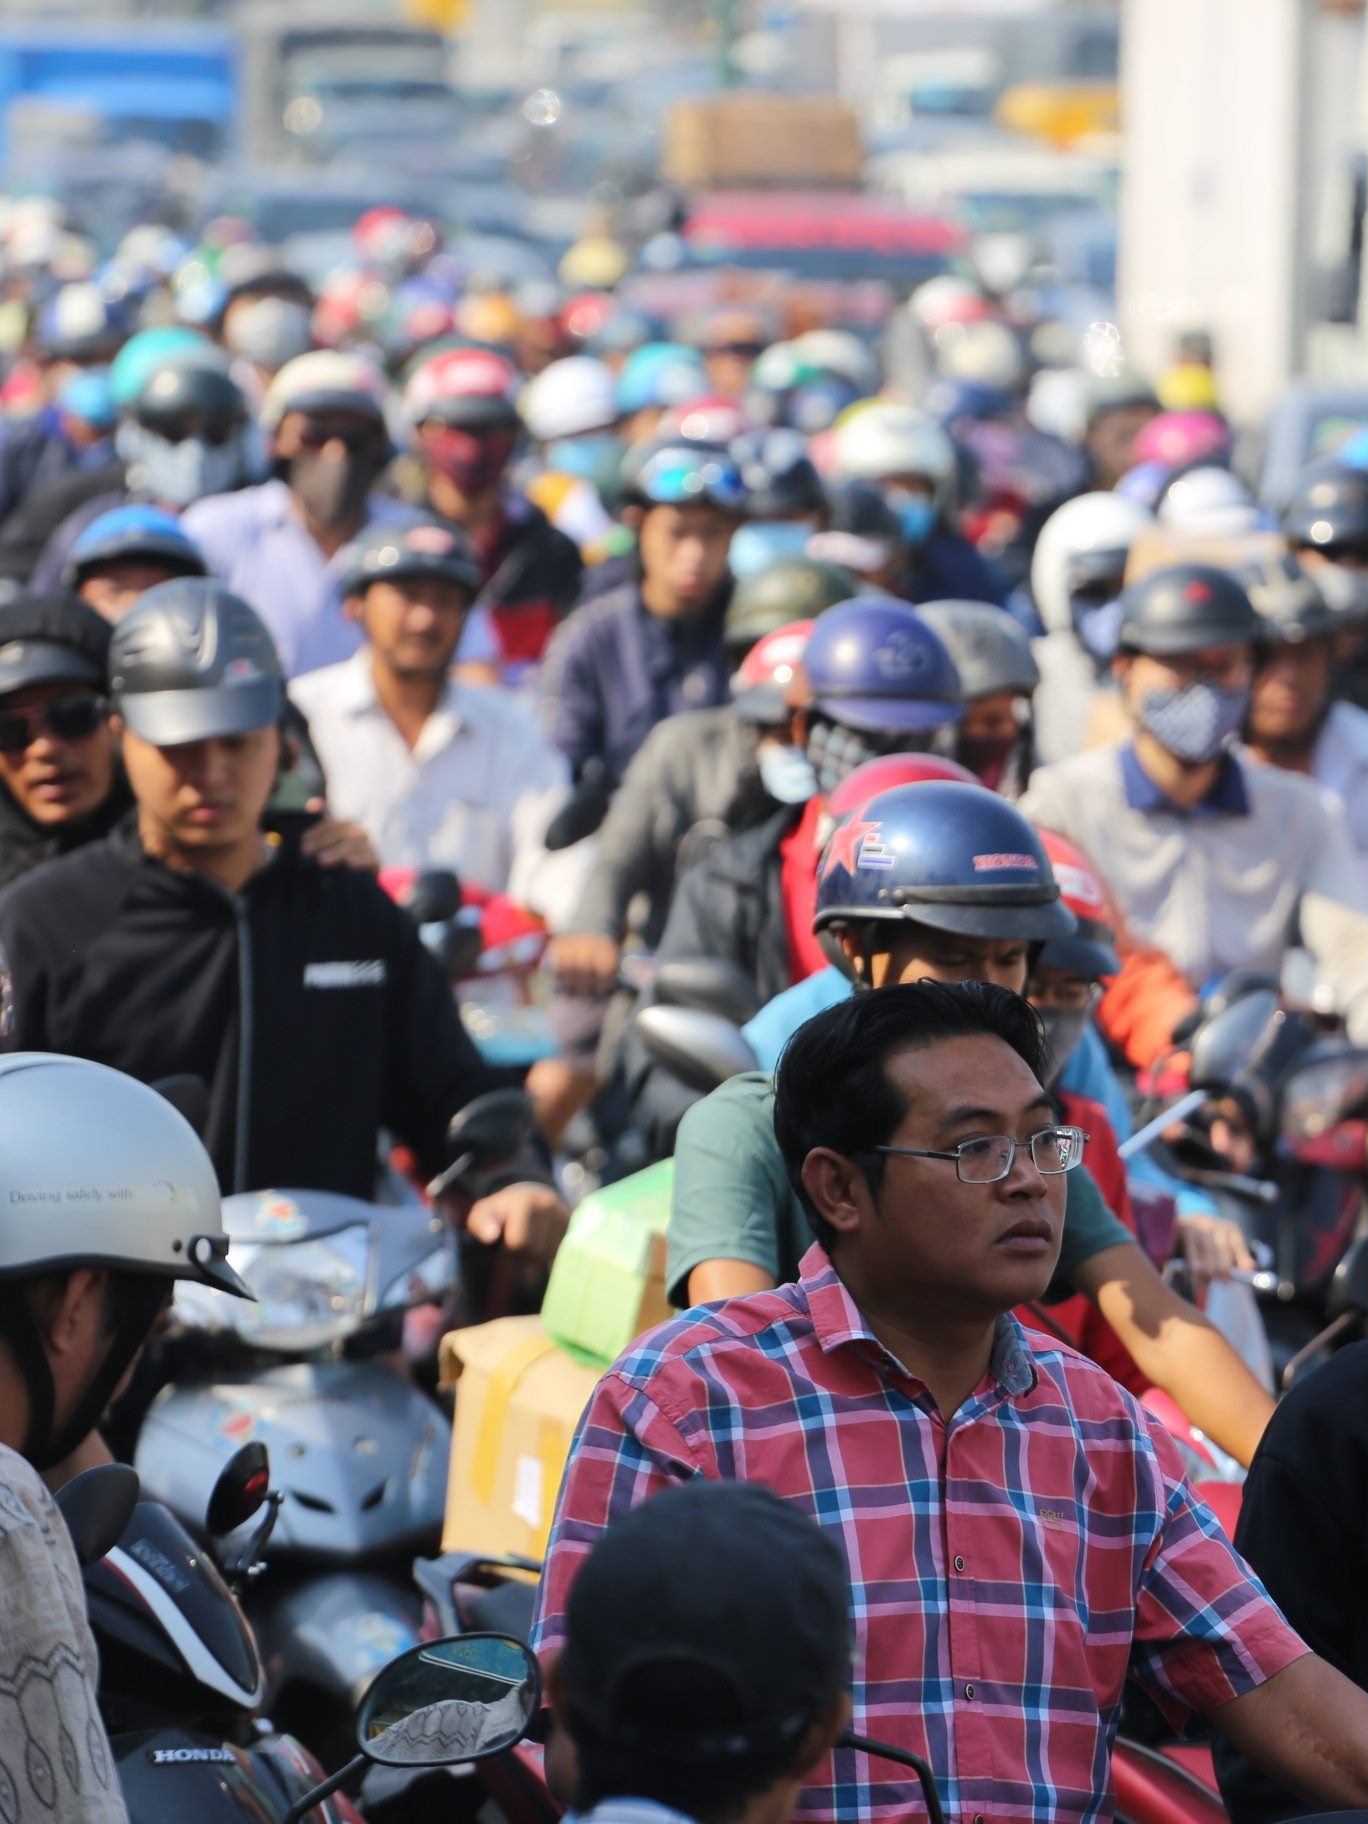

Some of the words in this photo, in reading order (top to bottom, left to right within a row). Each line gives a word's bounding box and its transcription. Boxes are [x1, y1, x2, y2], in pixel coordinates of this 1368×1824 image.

[9, 1189, 62, 1205] Driving
[66, 1185, 102, 1202] safely
[107, 1187, 133, 1201] with
[153, 1748, 236, 1763] HONDA
